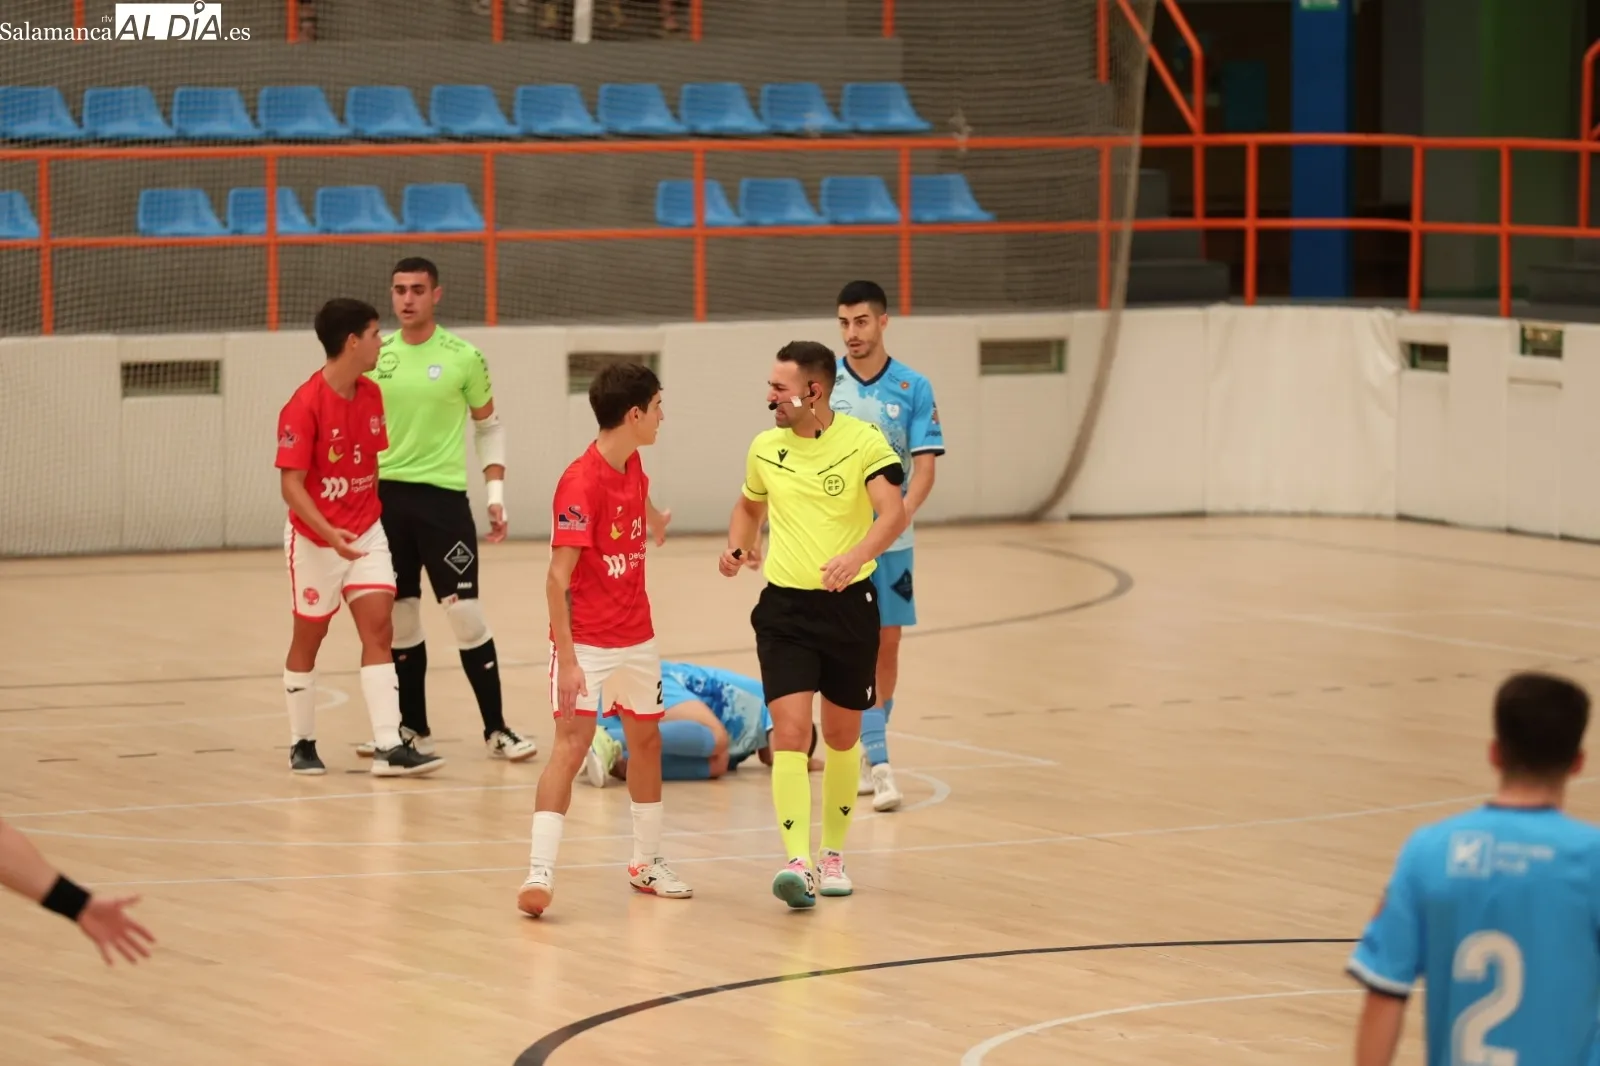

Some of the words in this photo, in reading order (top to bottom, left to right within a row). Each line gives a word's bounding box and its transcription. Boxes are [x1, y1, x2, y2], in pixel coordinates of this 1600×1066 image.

[353, 444, 362, 464] 5
[630, 516, 642, 540] 29
[1451, 929, 1525, 1066] 2
